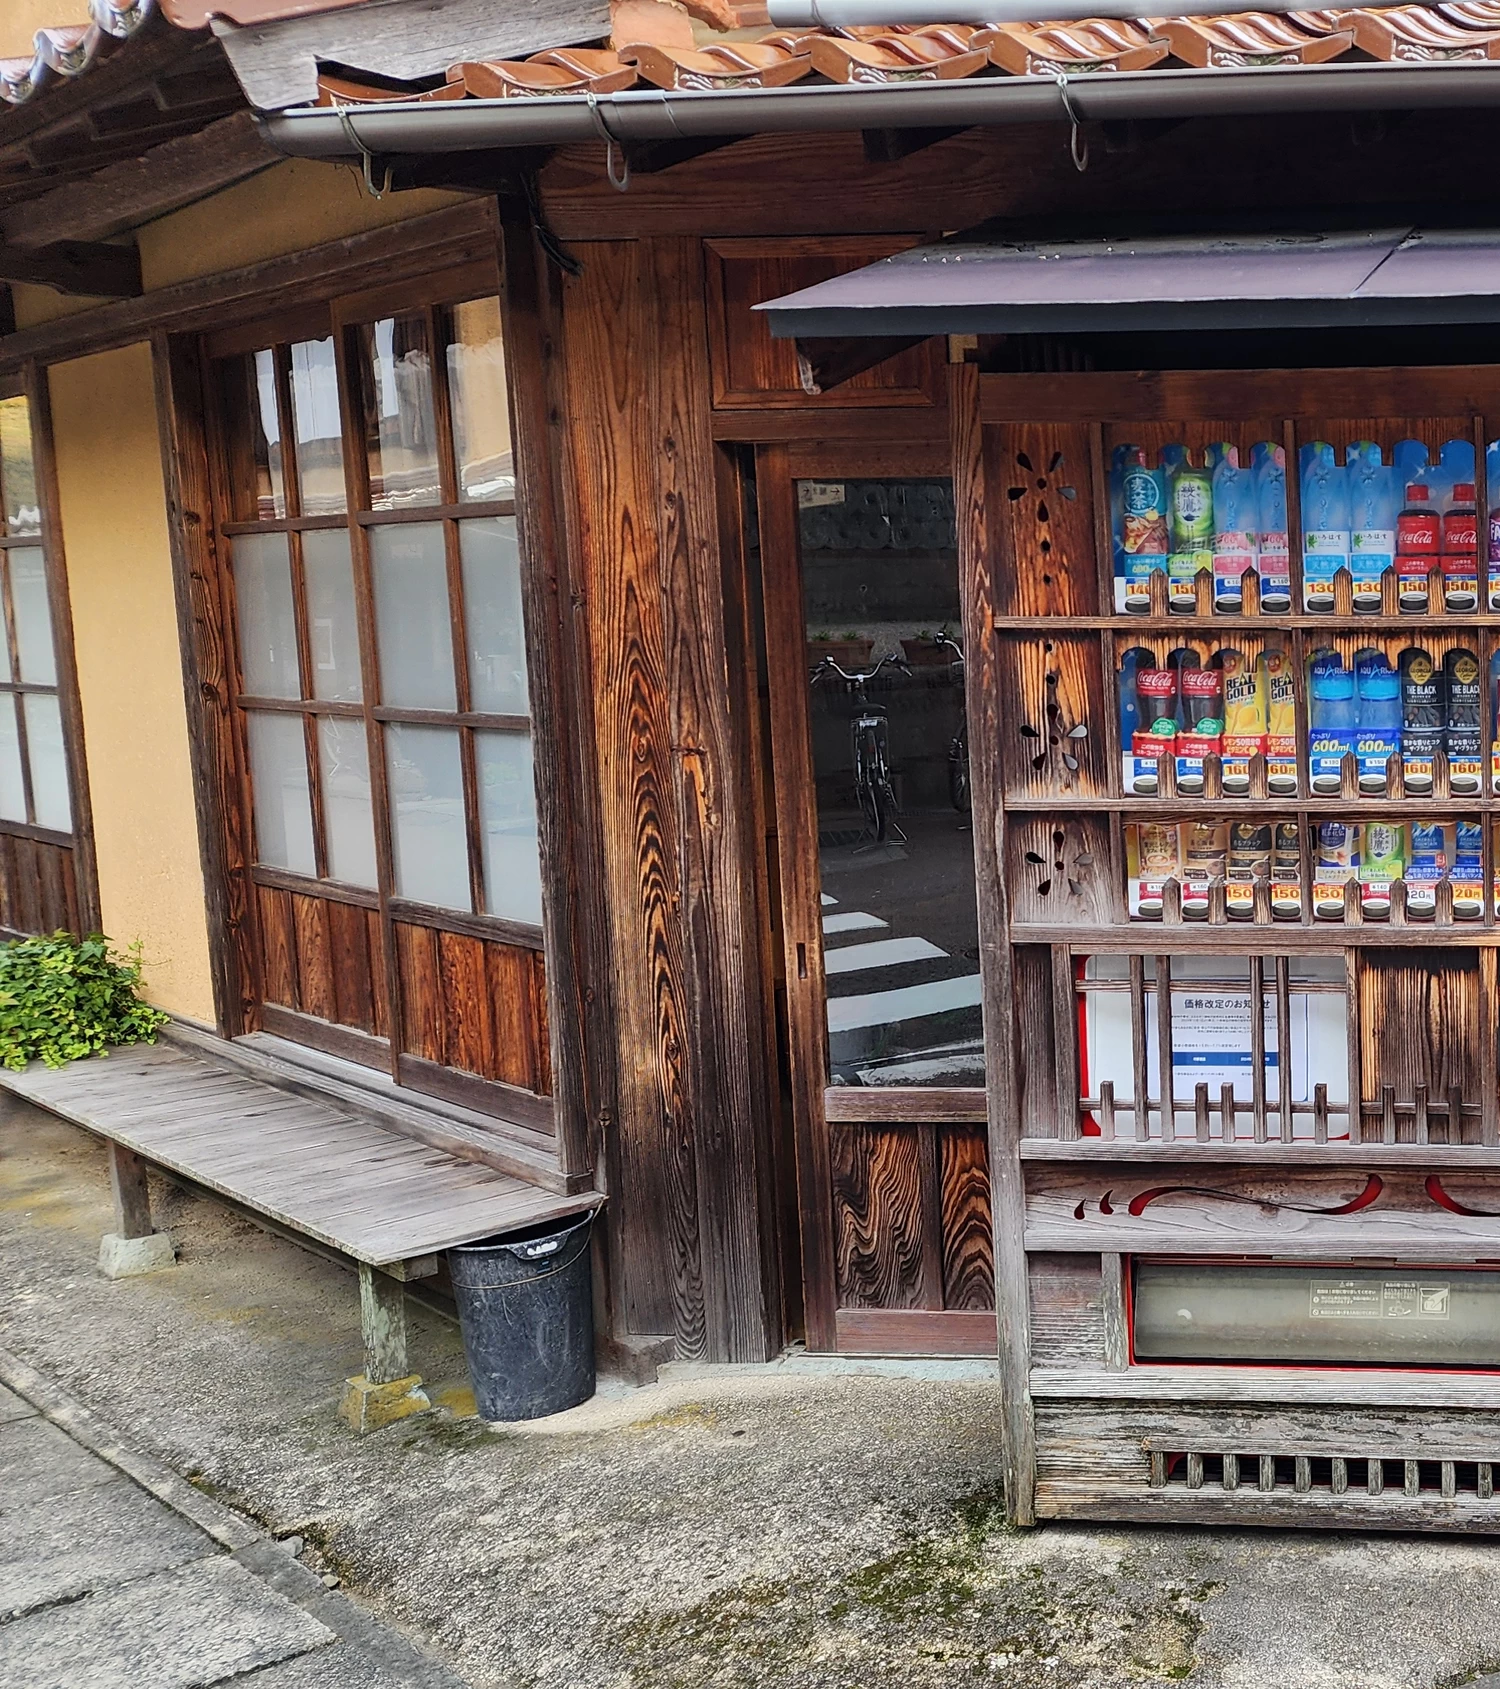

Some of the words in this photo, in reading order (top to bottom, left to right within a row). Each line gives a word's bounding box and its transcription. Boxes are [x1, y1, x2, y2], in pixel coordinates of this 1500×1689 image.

[1130, 477, 1148, 509] 麦茶
[1226, 673, 1255, 691] REAL
[1226, 684, 1256, 700] GOLD
[1271, 684, 1295, 700] GOL
[1406, 685, 1416, 694] THE
[1417, 685, 1436, 694] BLACK
[1452, 685, 1462, 694] THE
[1312, 740, 1350, 752] 600ml
[1357, 740, 1395, 752] 600ml
[1374, 826, 1384, 851] 綾鷹
[1227, 889, 1252, 898] 150
[1273, 889, 1300, 898] 150
[1184, 999, 1271, 1009] 価格改定のお知せ
